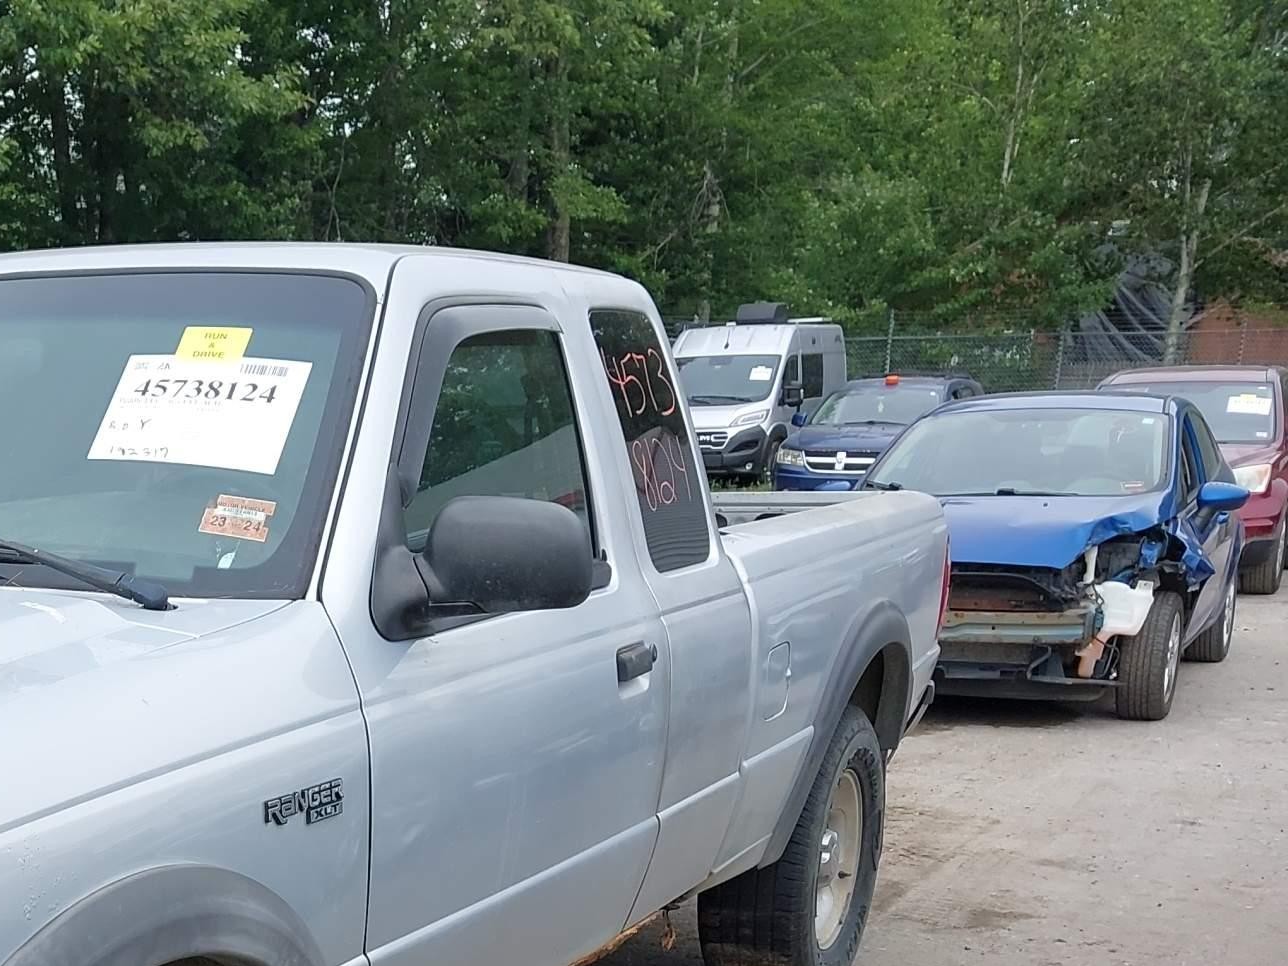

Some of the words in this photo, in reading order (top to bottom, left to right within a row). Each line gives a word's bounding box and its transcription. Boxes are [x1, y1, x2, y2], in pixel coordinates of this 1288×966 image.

[204, 332, 228, 340] RUN
[192, 350, 225, 359] DRIVE
[133, 379, 278, 404] 45738124
[601, 347, 676, 418] 4573
[632, 435, 692, 512] 8124
[210, 514, 227, 528] 23
[243, 520, 262, 532] 24
[314, 802, 341, 820] XLT
